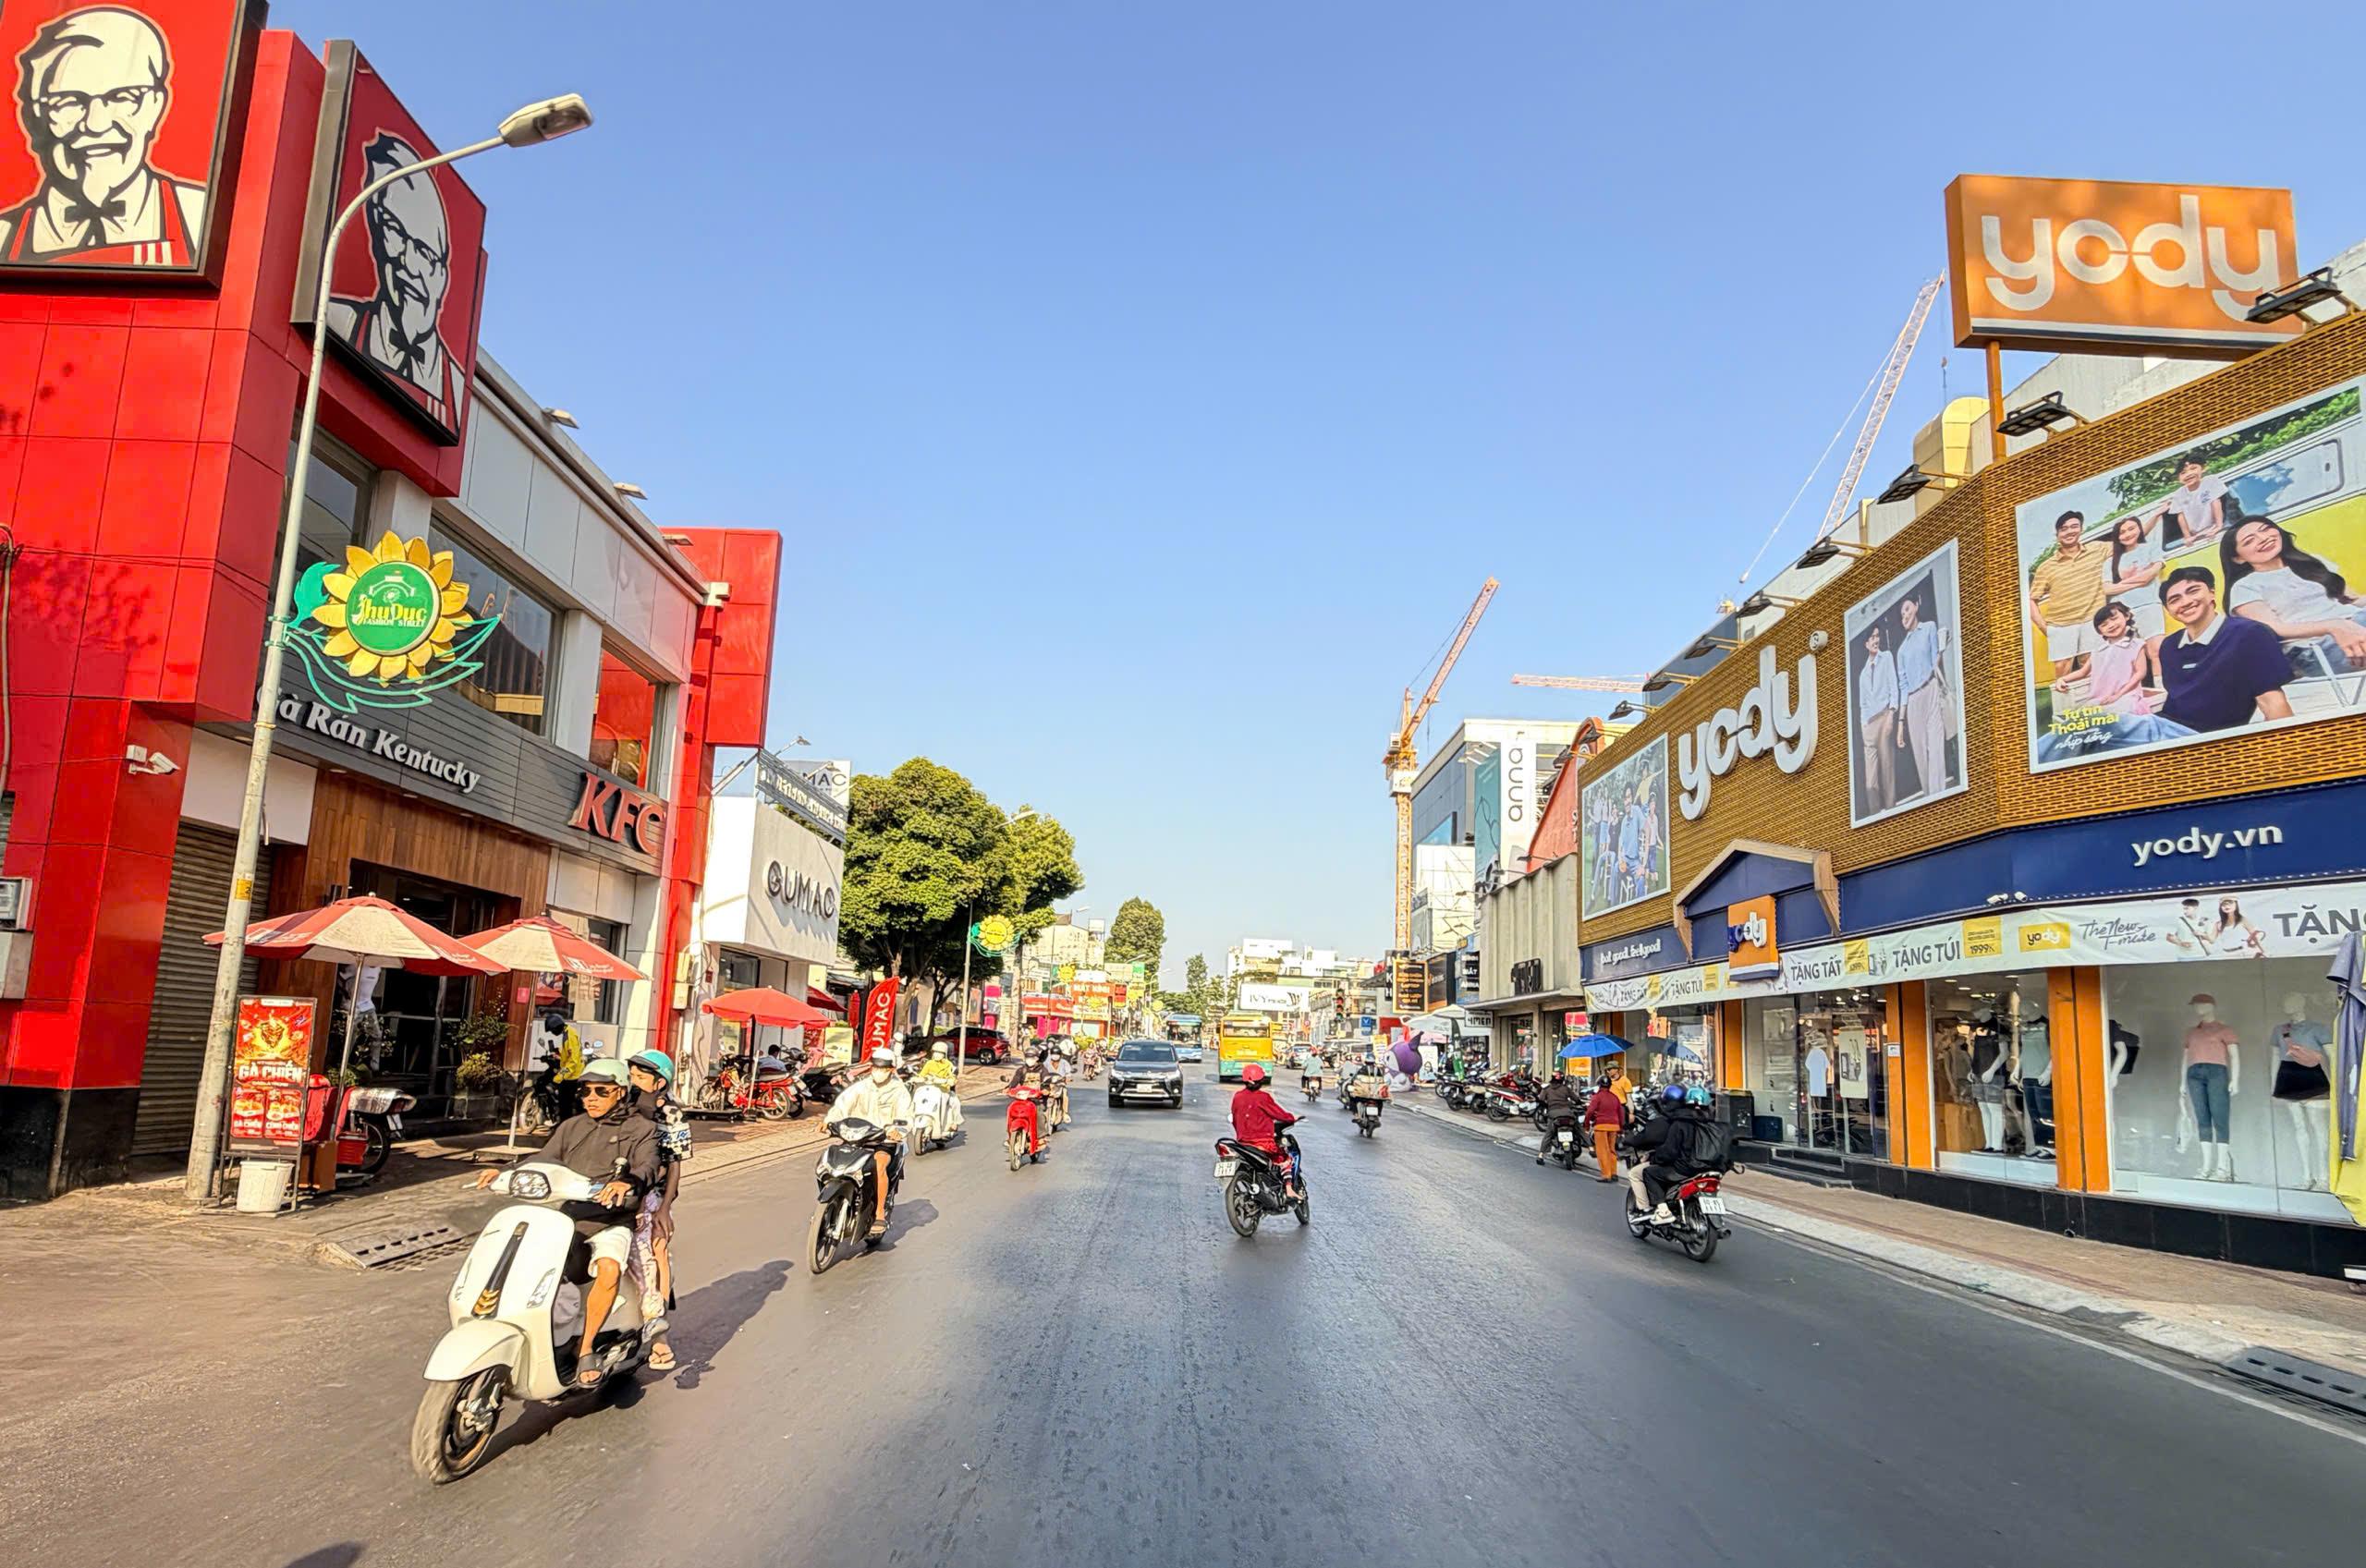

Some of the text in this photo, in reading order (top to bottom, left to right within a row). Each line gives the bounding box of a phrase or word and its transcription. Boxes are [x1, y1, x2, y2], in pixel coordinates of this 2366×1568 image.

[1982, 194, 2280, 322] yody
[257, 686, 481, 794] à Rán Kentucky
[1678, 645, 1818, 820] yody
[1508, 748, 1524, 821] anna
[567, 771, 666, 857] KFC
[2130, 825, 2284, 867] yody.vn
[766, 860, 835, 919] GUMAC
[1727, 912, 1767, 953] yody
[2027, 928, 2061, 946] yody
[2078, 918, 2148, 940] The New
[2273, 904, 2366, 943] TẶN
[1791, 954, 1842, 986] TẶNG TẤT
[1893, 936, 1960, 972] TẶNG TÚI
[1671, 979, 1691, 1000] TẶNG
[1692, 977, 1703, 994] TÚI
[872, 992, 891, 1051] UMAC
